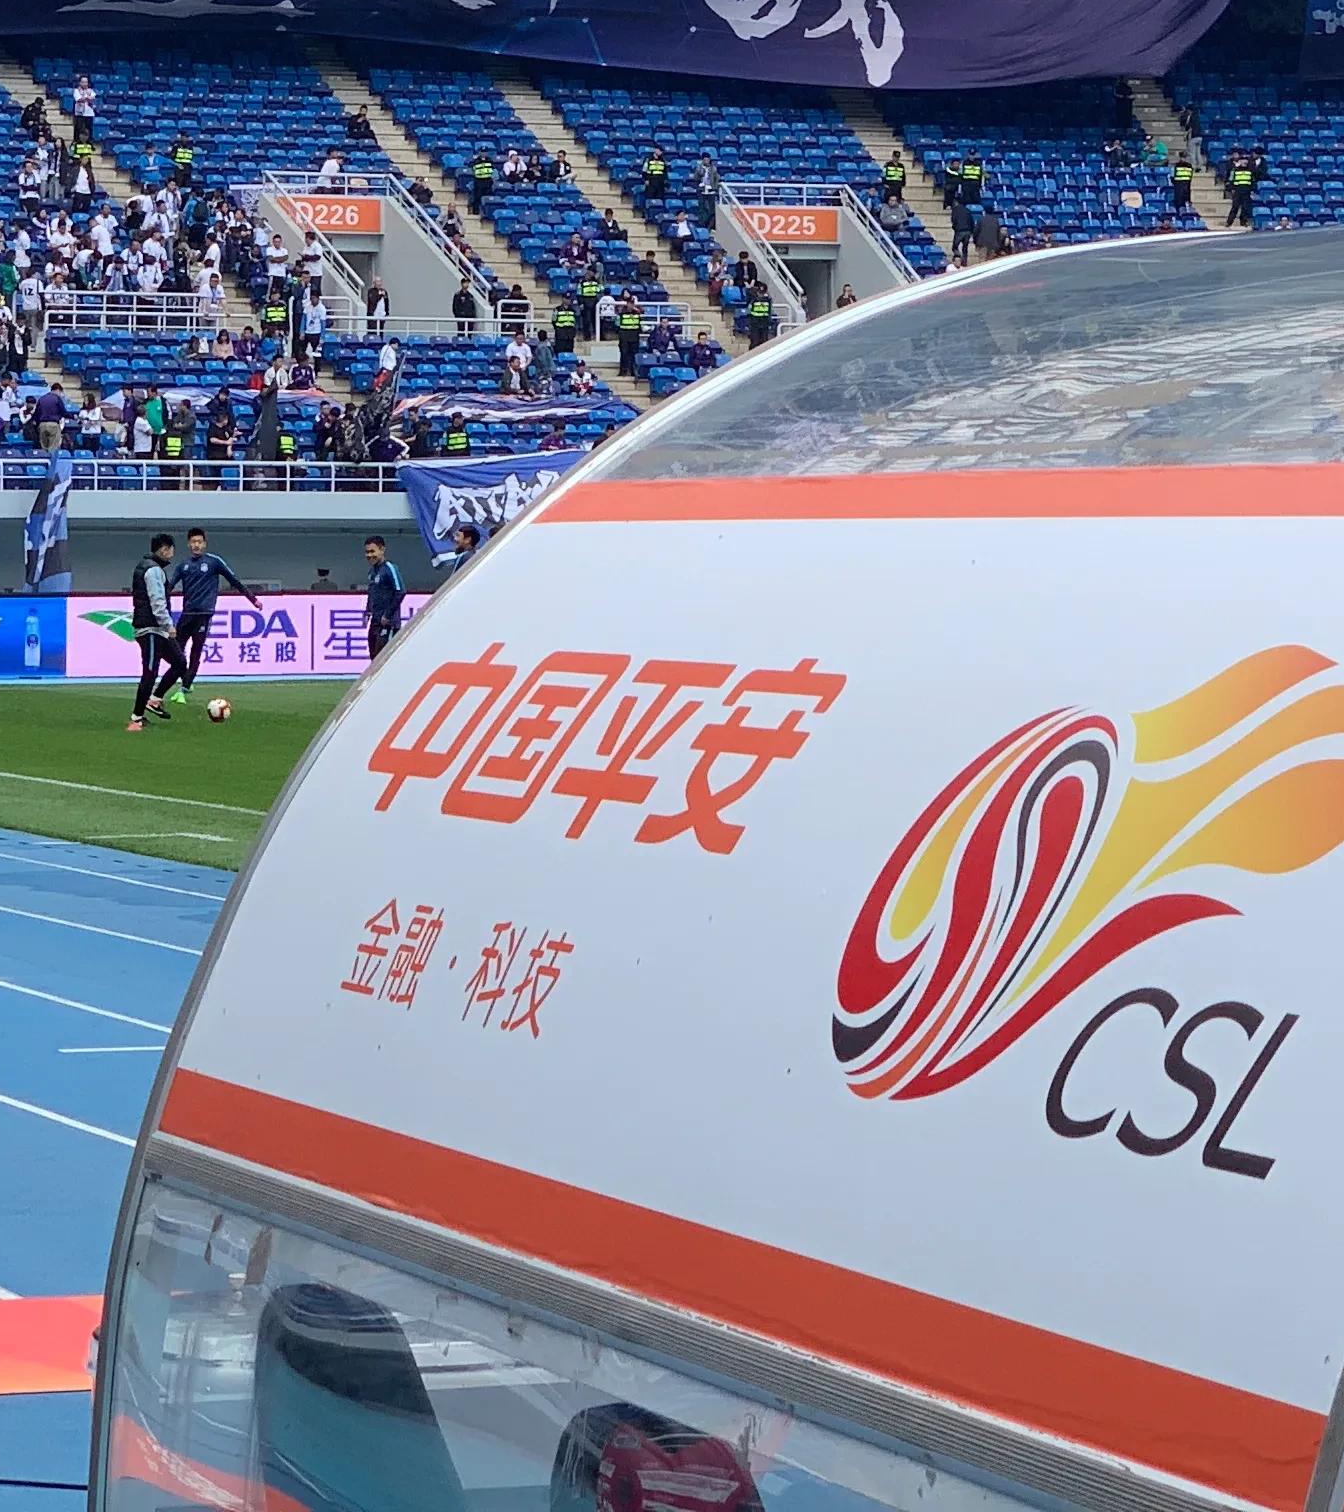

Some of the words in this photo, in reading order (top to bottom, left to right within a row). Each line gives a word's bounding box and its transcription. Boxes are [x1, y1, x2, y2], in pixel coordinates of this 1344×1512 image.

[294, 202, 360, 226] D226
[752, 212, 817, 236] D225
[367, 641, 848, 855] 中国平安
[1044, 987, 1300, 1181] CSL
